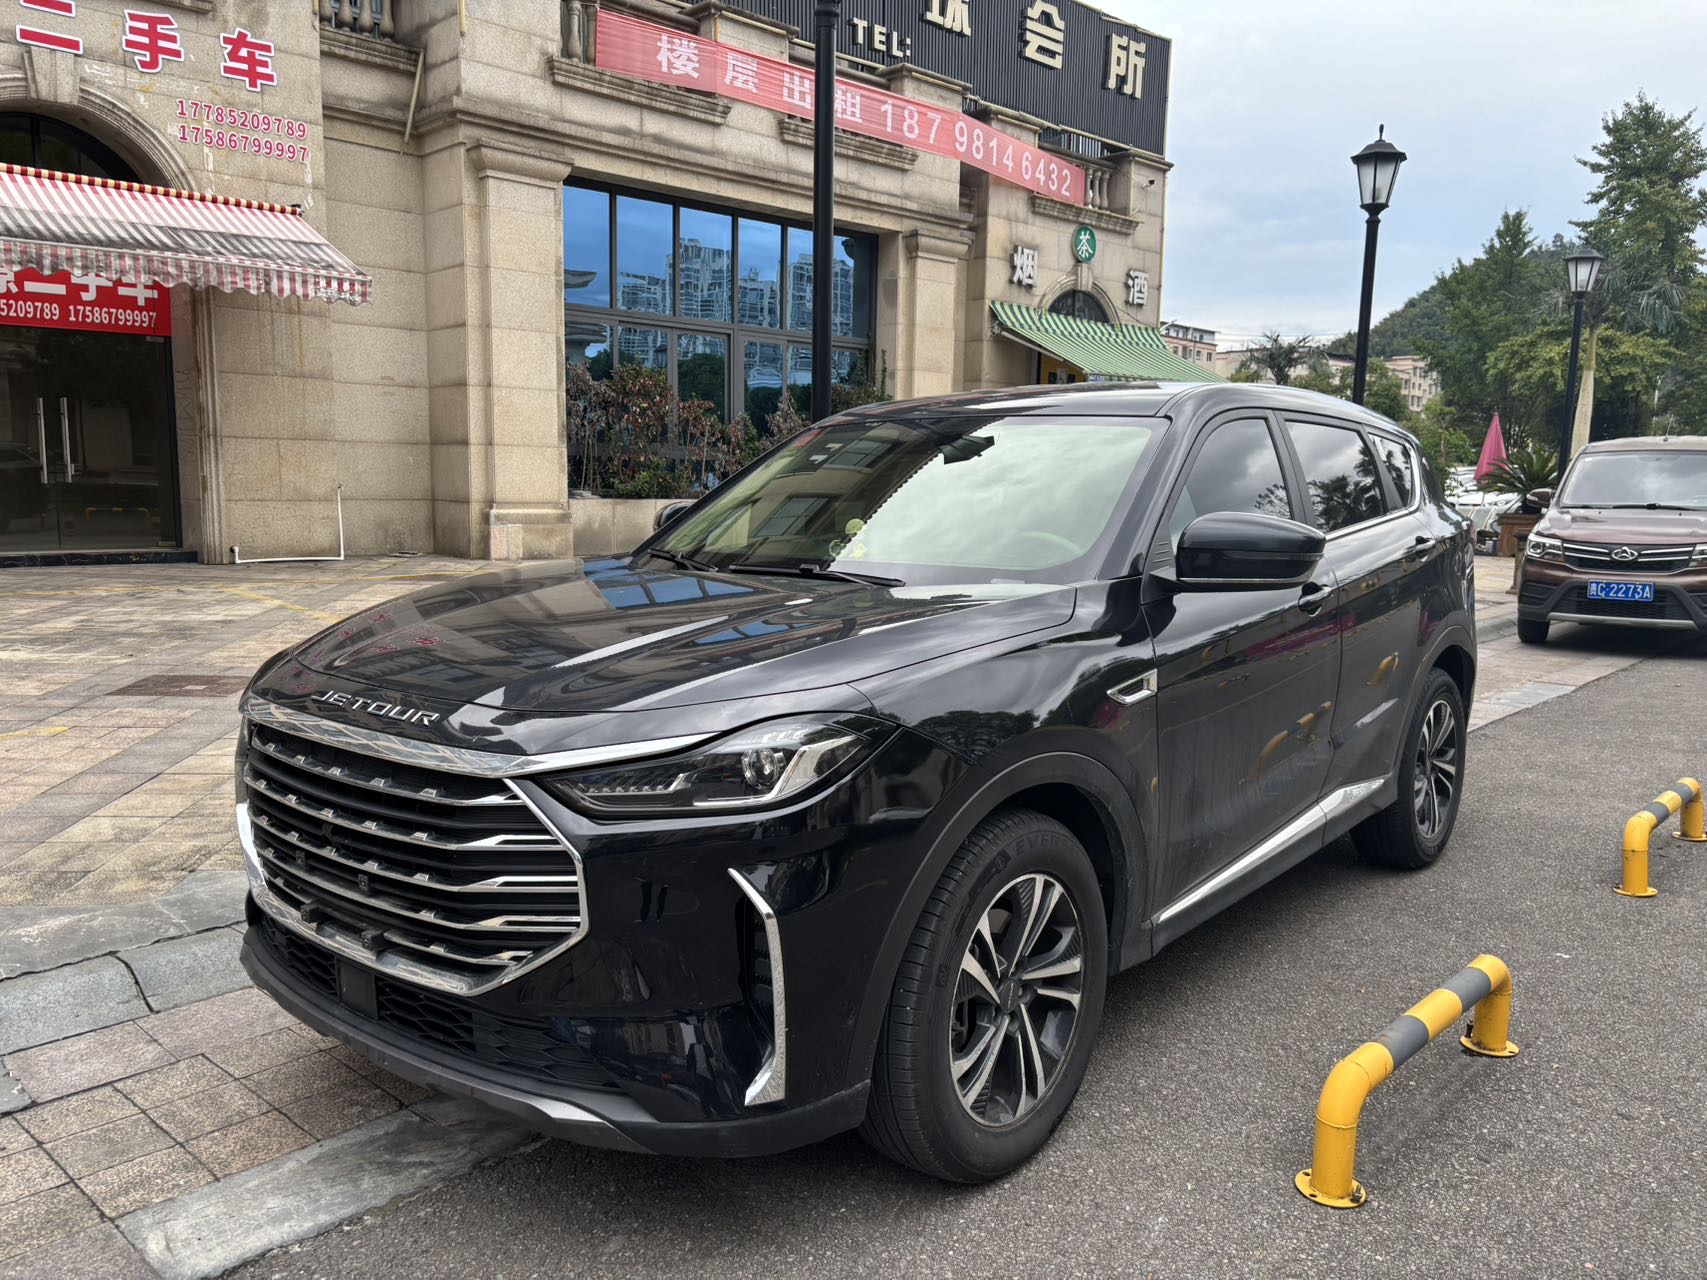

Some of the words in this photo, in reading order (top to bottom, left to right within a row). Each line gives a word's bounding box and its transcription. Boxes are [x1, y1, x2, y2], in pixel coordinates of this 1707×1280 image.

[16, 0, 278, 92] 二手车
[853, 17, 911, 58] TEL:
[177, 99, 308, 139] 17785209789
[656, 33, 863, 123] 楼层出租
[880, 100, 942, 144] 187
[954, 120, 1014, 173] 9814
[1021, 151, 1071, 197] 6432
[178, 124, 309, 163] 17586799997
[1076, 231, 1094, 259] 茶
[1012, 246, 1038, 287] 烟
[1128, 269, 1149, 306] 酒
[68, 305, 157, 328] 17586799997
[311, 690, 440, 726] JETOUR
